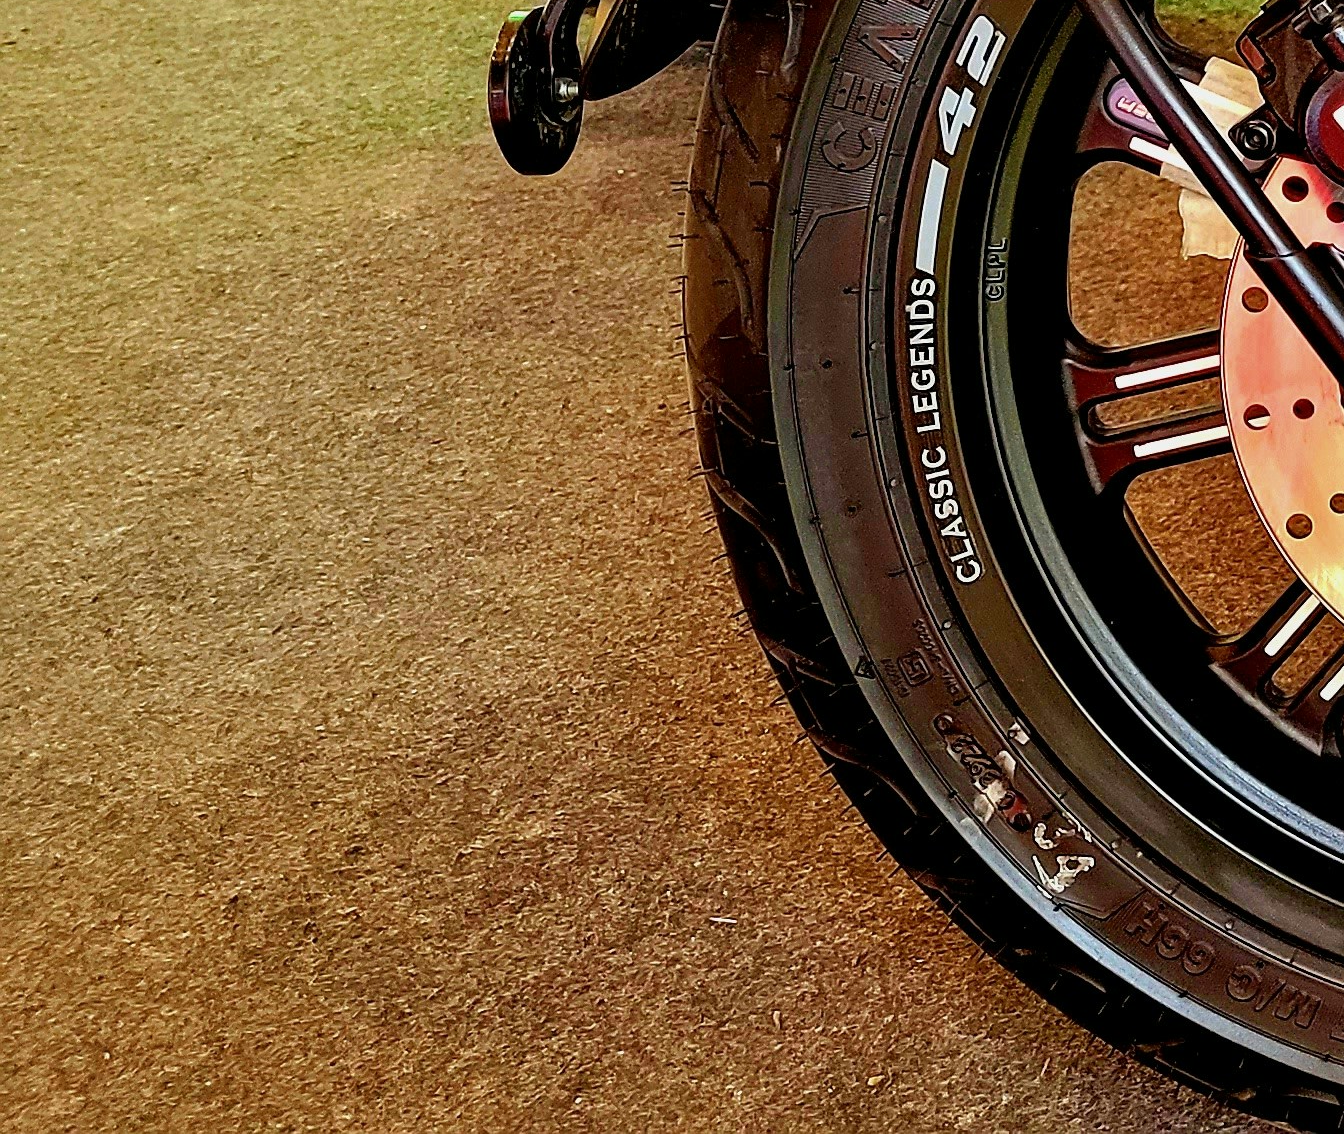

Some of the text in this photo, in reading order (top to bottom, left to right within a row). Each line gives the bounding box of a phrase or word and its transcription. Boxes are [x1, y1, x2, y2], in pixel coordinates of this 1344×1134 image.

[938, 15, 1008, 156] 42
[985, 237, 1009, 303] CLPL
[905, 277, 941, 433] LEGENDS
[921, 445, 984, 584] CLASSIC
[1124, 900, 1216, 976] 66H
[1224, 964, 1324, 1029] M/C
